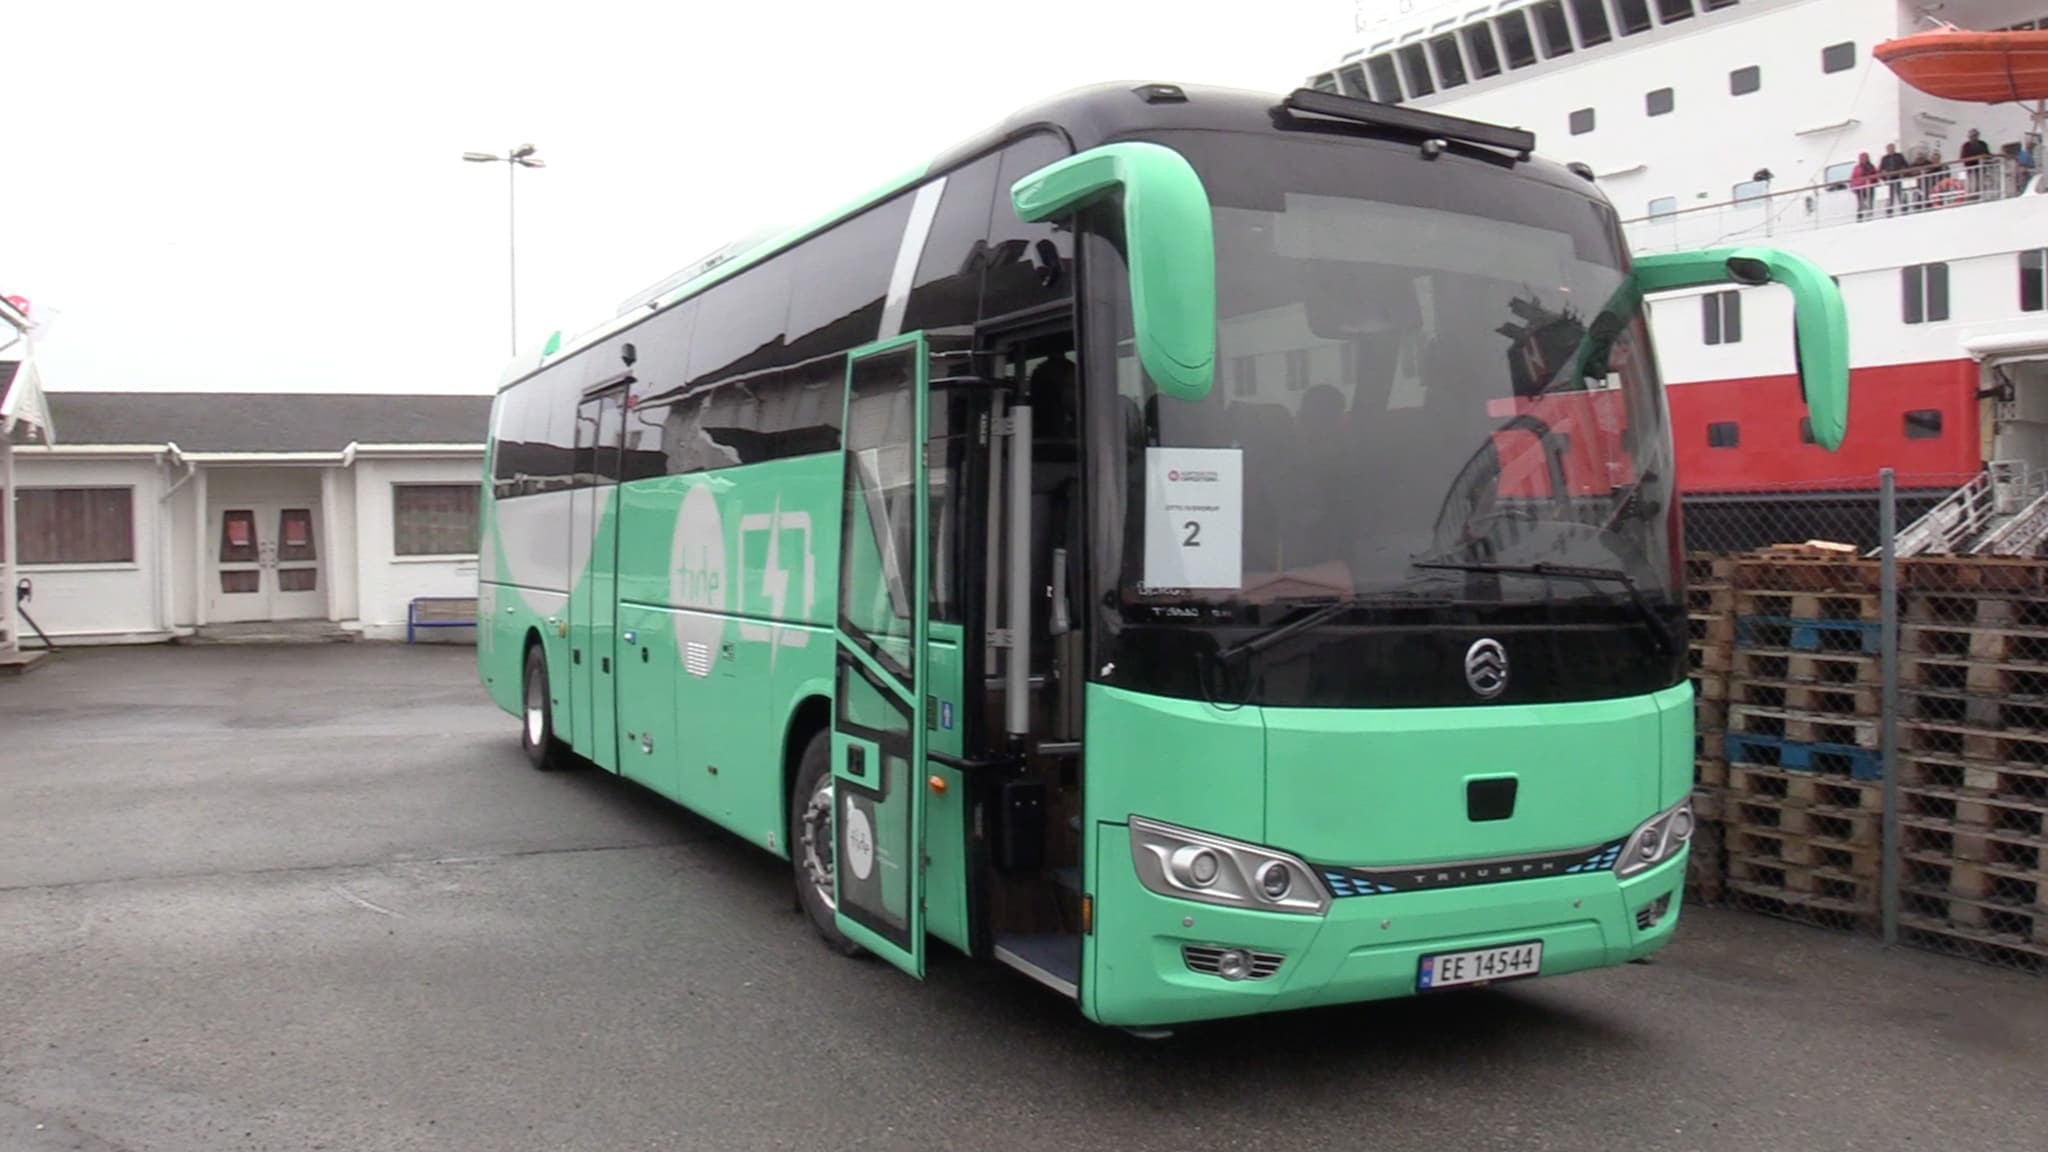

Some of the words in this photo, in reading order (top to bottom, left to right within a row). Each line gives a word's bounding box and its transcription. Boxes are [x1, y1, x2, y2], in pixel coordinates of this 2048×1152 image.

[1182, 520, 1201, 547] 2
[1414, 862, 1554, 883] TRIUMPH
[1441, 956, 1465, 982] EE
[1475, 947, 1534, 977] 14544
